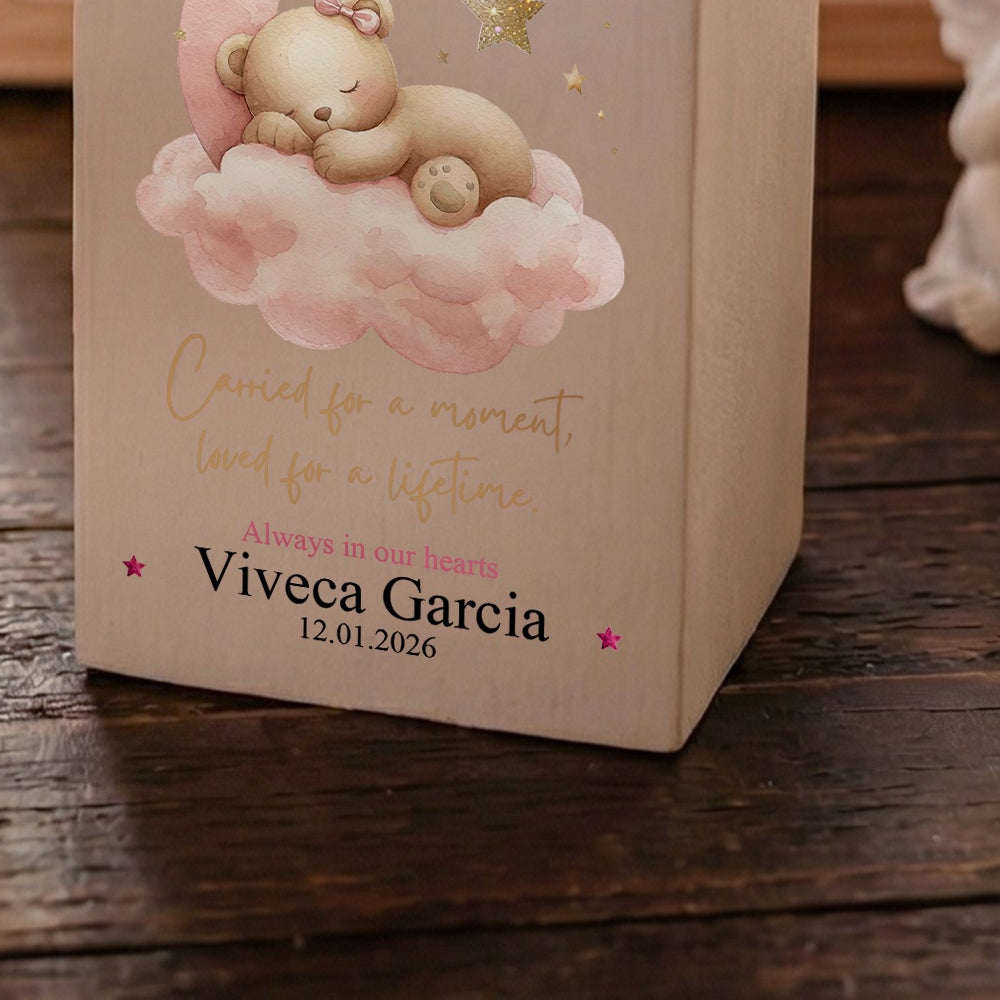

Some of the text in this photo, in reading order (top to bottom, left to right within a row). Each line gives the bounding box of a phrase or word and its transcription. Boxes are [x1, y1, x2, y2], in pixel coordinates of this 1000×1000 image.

[166, 333, 584, 453] Carried for a moment,
[197, 430, 540, 523] loved for a lifetime.
[194, 545, 549, 642] Viveca Garcia
[241, 520, 499, 579] Always in our hearts
[300, 616, 437, 659] 12.01.2026
